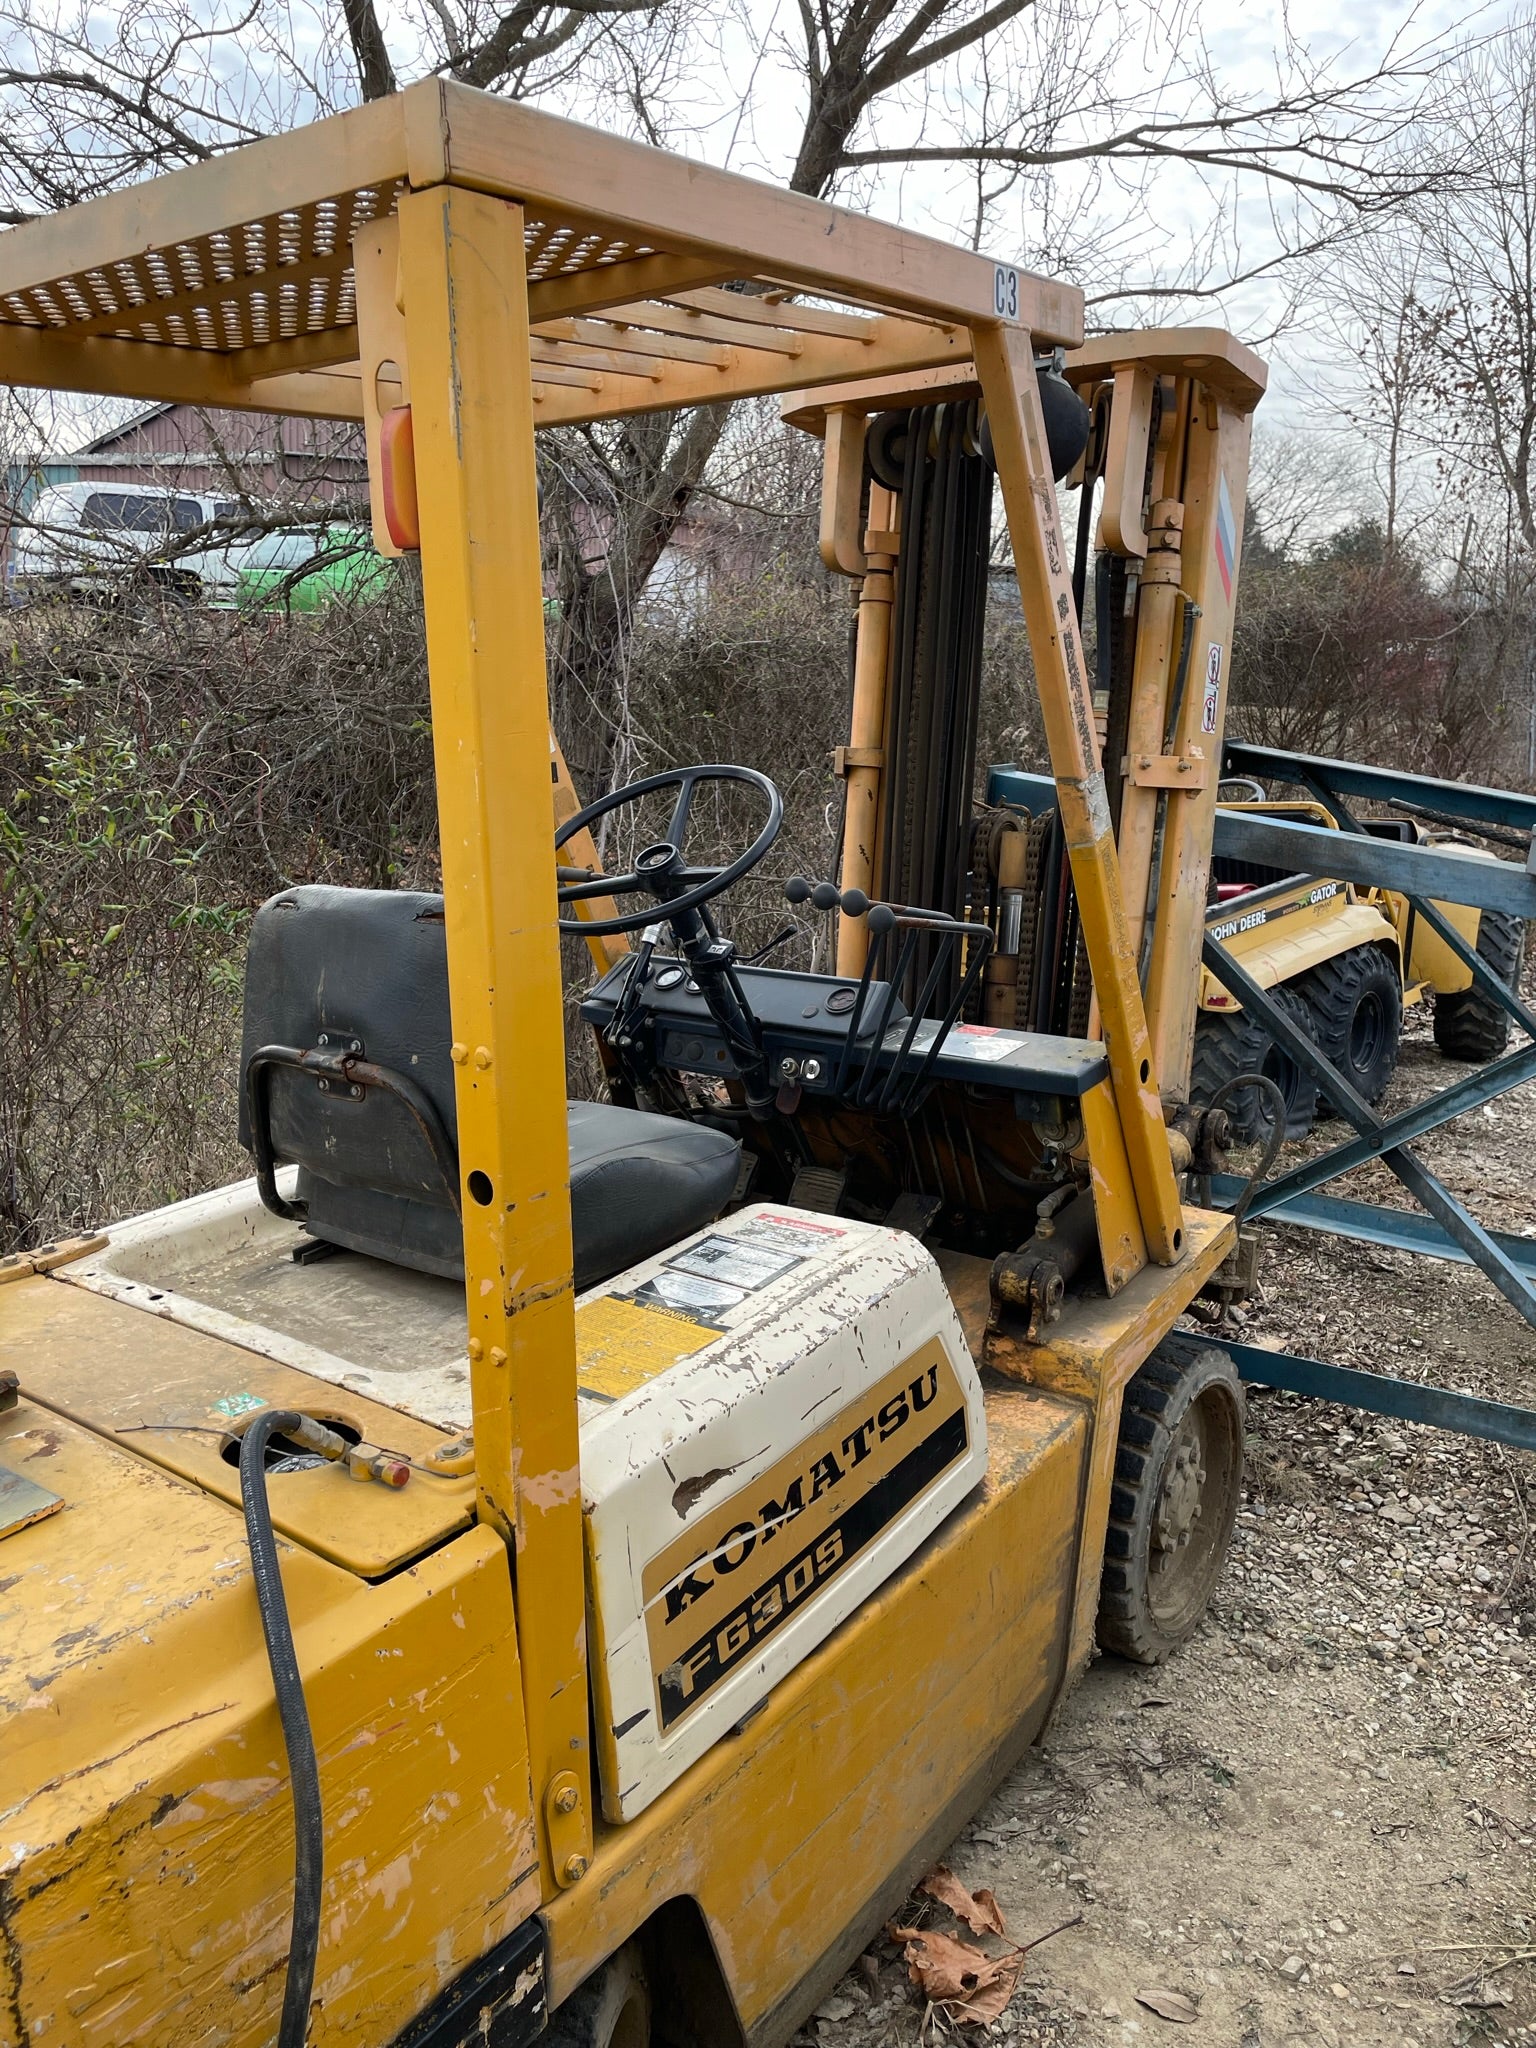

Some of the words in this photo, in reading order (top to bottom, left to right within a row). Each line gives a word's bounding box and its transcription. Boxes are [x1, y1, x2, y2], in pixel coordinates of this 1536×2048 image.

[996, 268, 1017, 317] C3
[1310, 883, 1337, 904] GATOR
[1240, 909, 1267, 932] DEERE
[644, 1302, 699, 1325] WARNING
[660, 1363, 940, 1626] KOMATSU
[681, 1528, 844, 1699] FG30S
